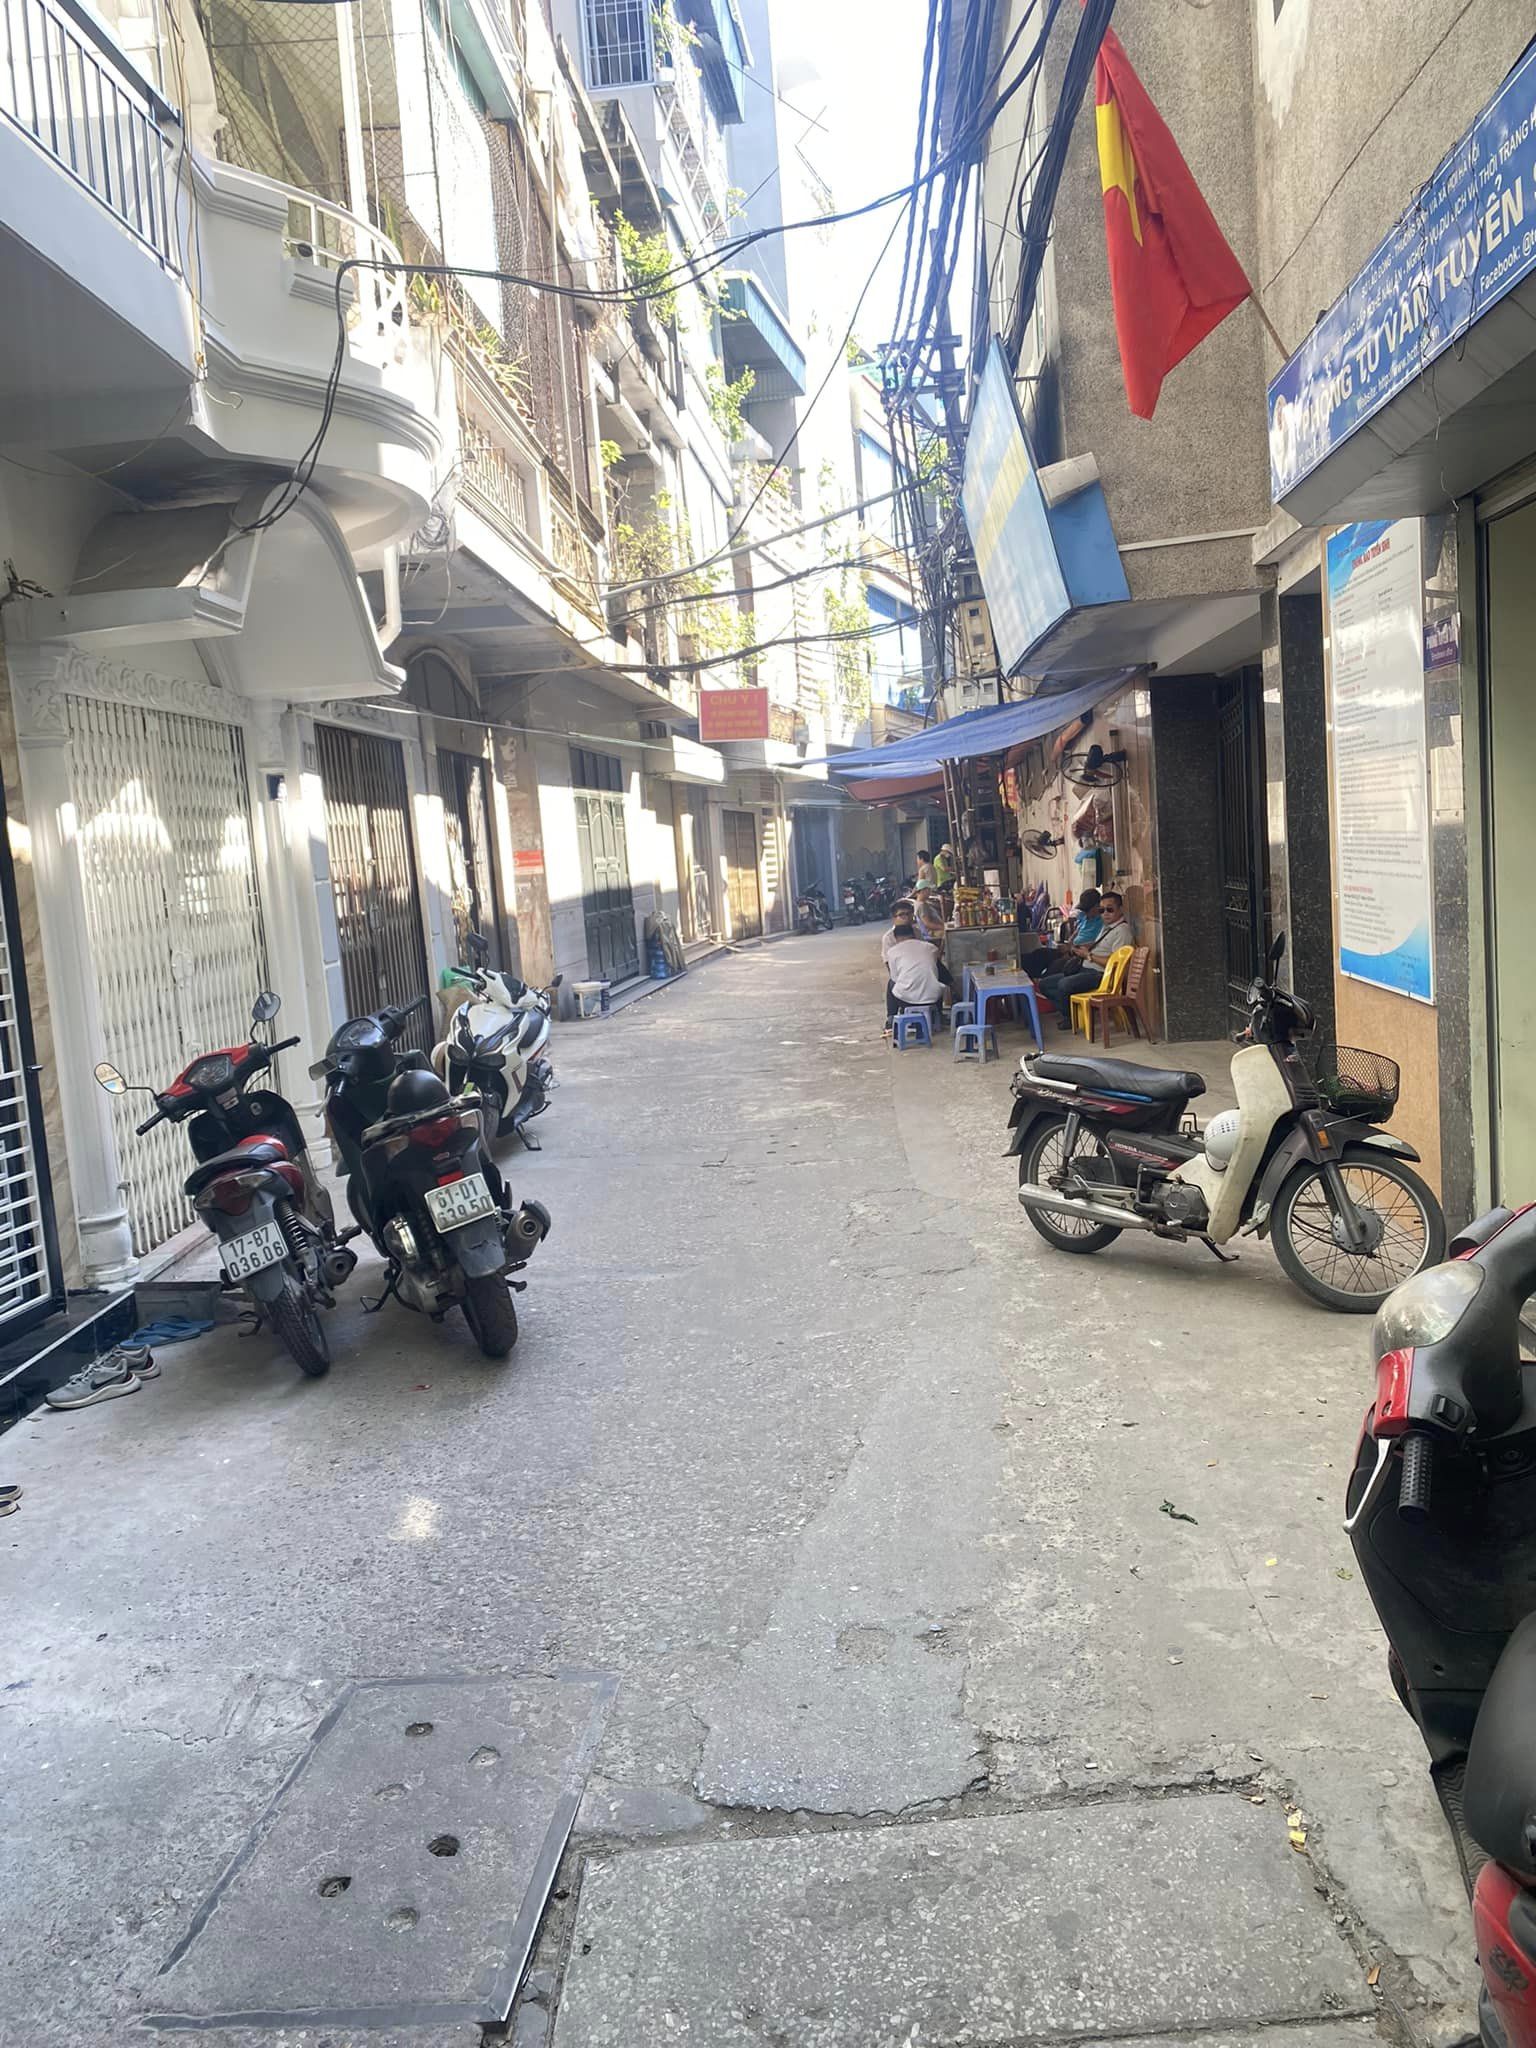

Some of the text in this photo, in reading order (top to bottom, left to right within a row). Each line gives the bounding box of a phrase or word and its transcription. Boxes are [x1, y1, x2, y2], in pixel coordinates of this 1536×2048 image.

[1439, 211, 1450, 235] DU
[1479, 152, 1497, 189] THỜI
[1498, 120, 1528, 166] TRANG
[1384, 268, 1429, 354] VẤN
[1434, 173, 1524, 303] TUYỂN
[1480, 244, 1521, 295] Facebook:
[436, 1179, 478, 1208] 61-D1
[228, 1226, 270, 1258] 17-B7
[229, 1241, 284, 1278] 036.06
